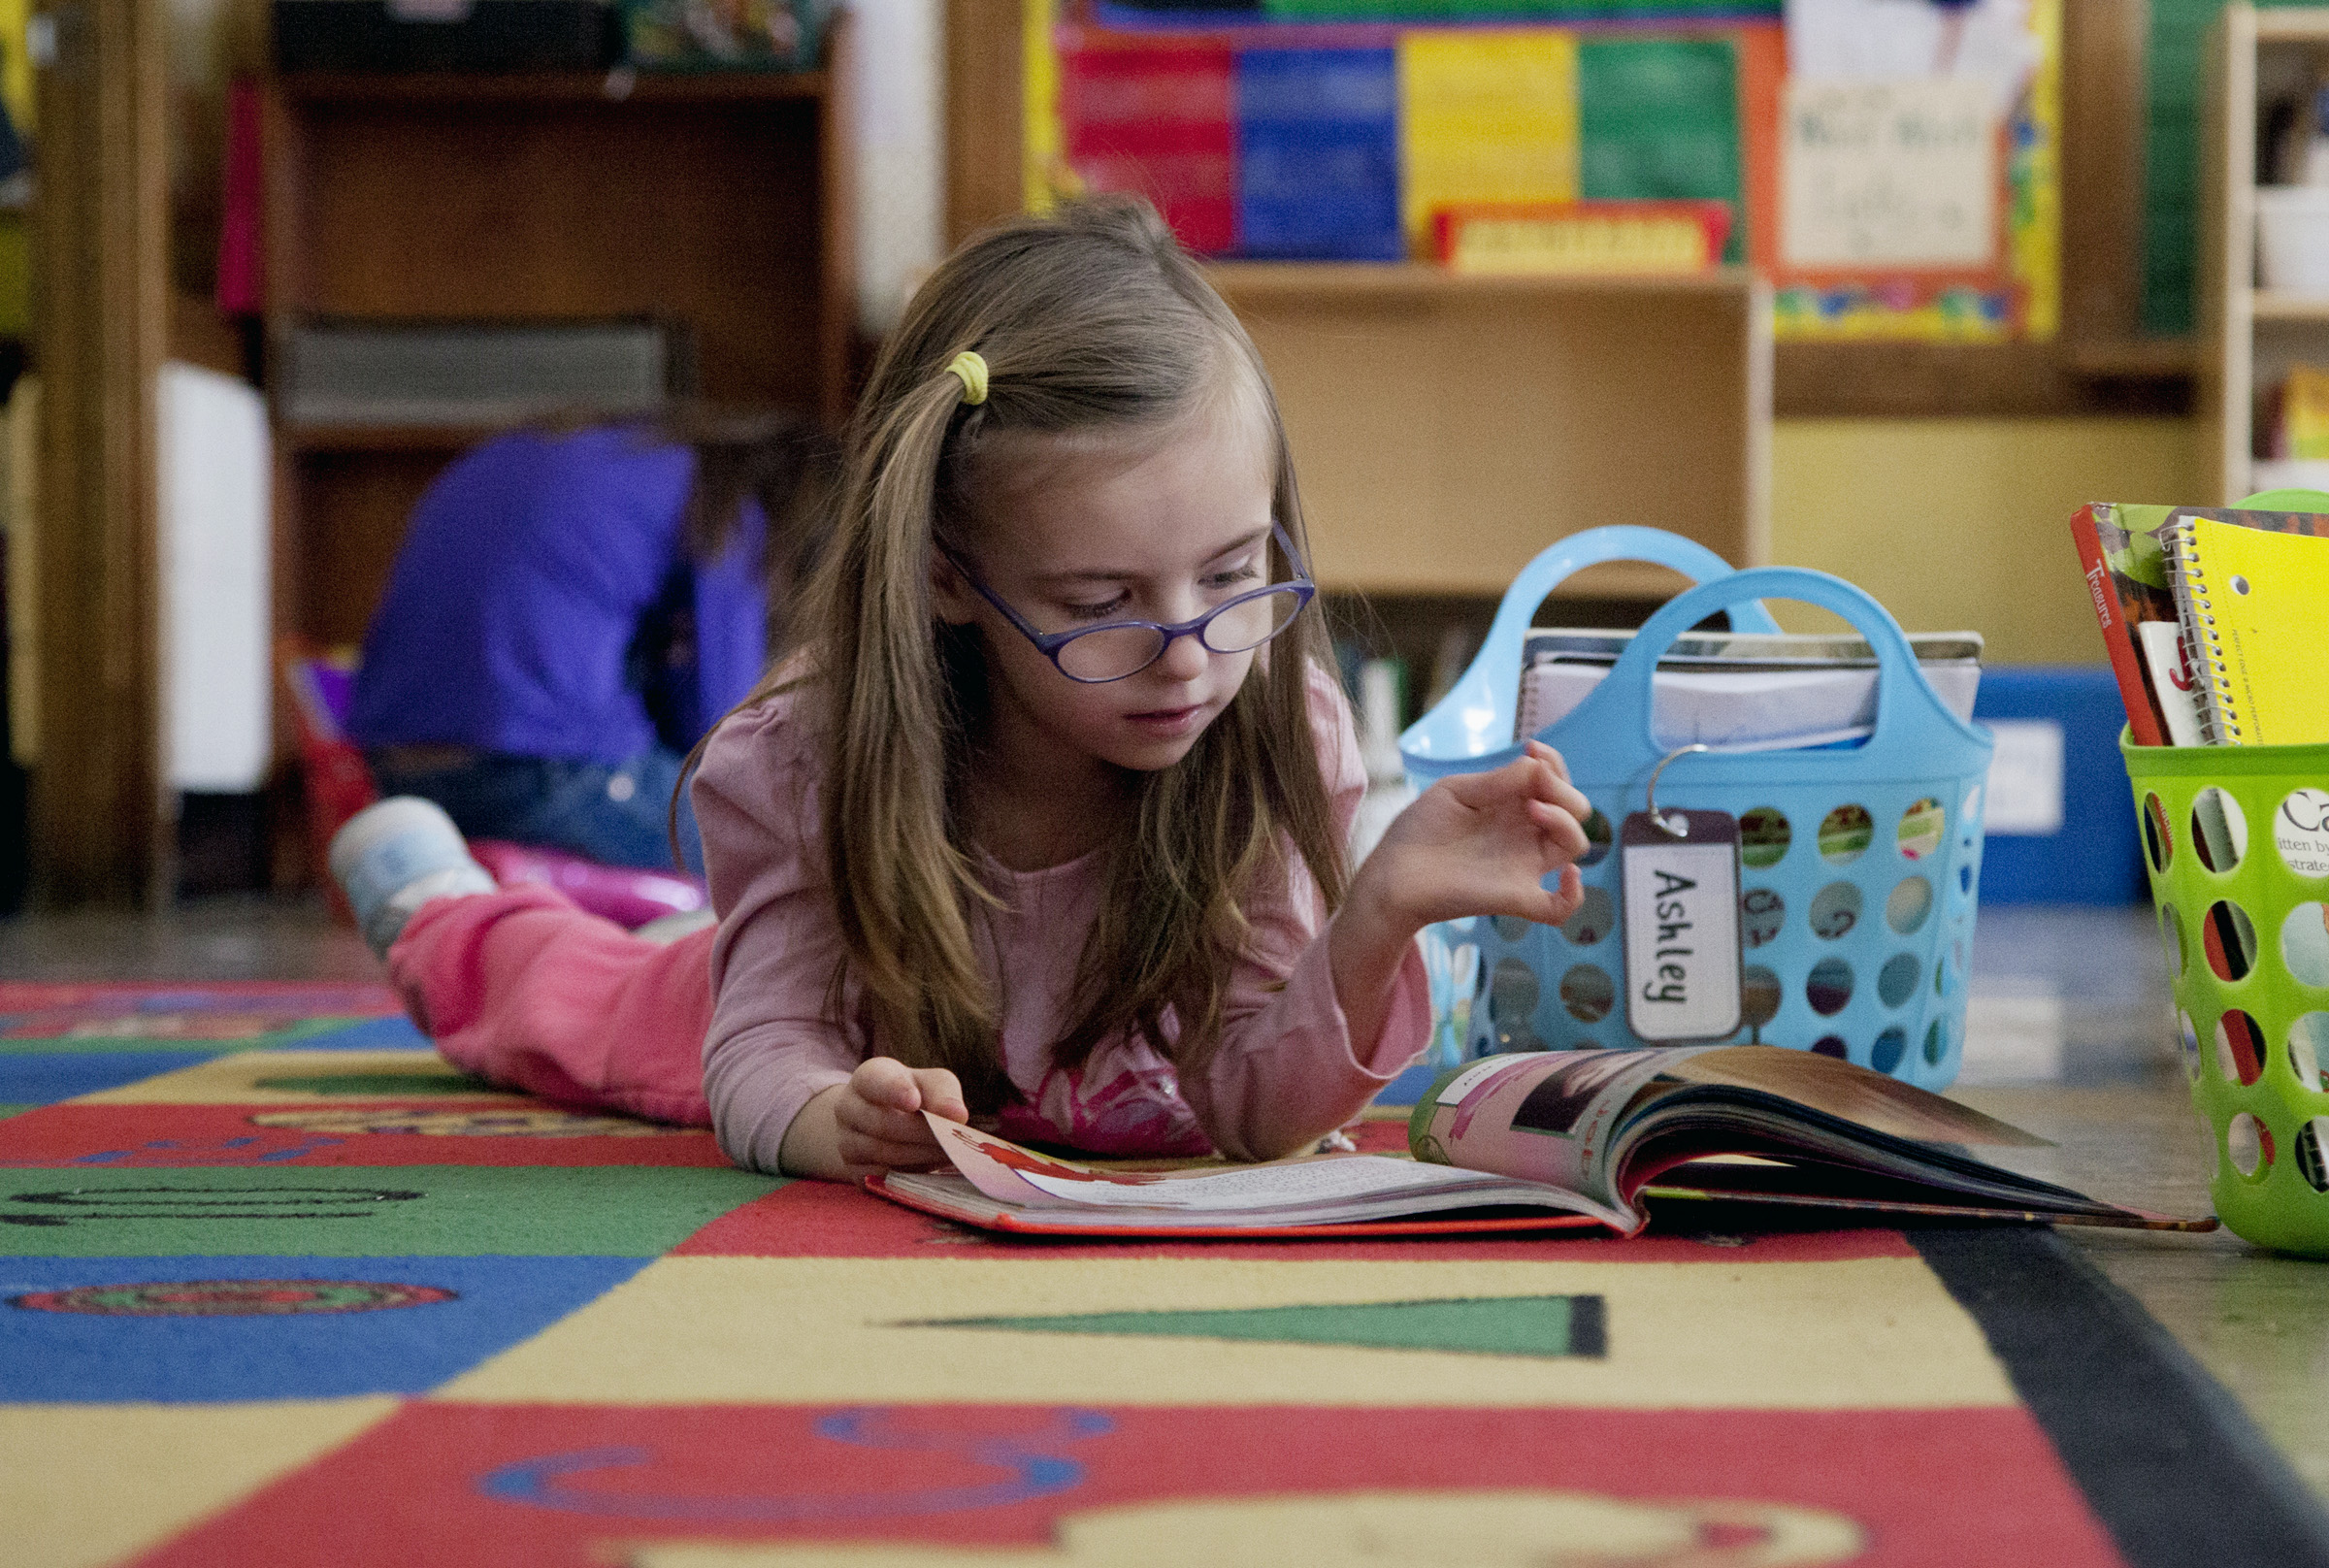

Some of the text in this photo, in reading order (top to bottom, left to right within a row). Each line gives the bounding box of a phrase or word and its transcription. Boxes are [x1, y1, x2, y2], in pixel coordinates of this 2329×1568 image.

[2086, 558, 2113, 629] Treasures
[2233, 629, 2244, 658] PERFECT
[2278, 836, 2312, 852] itten
[2287, 859, 2329, 872] strate
[1642, 869, 1697, 1003] Ashley
